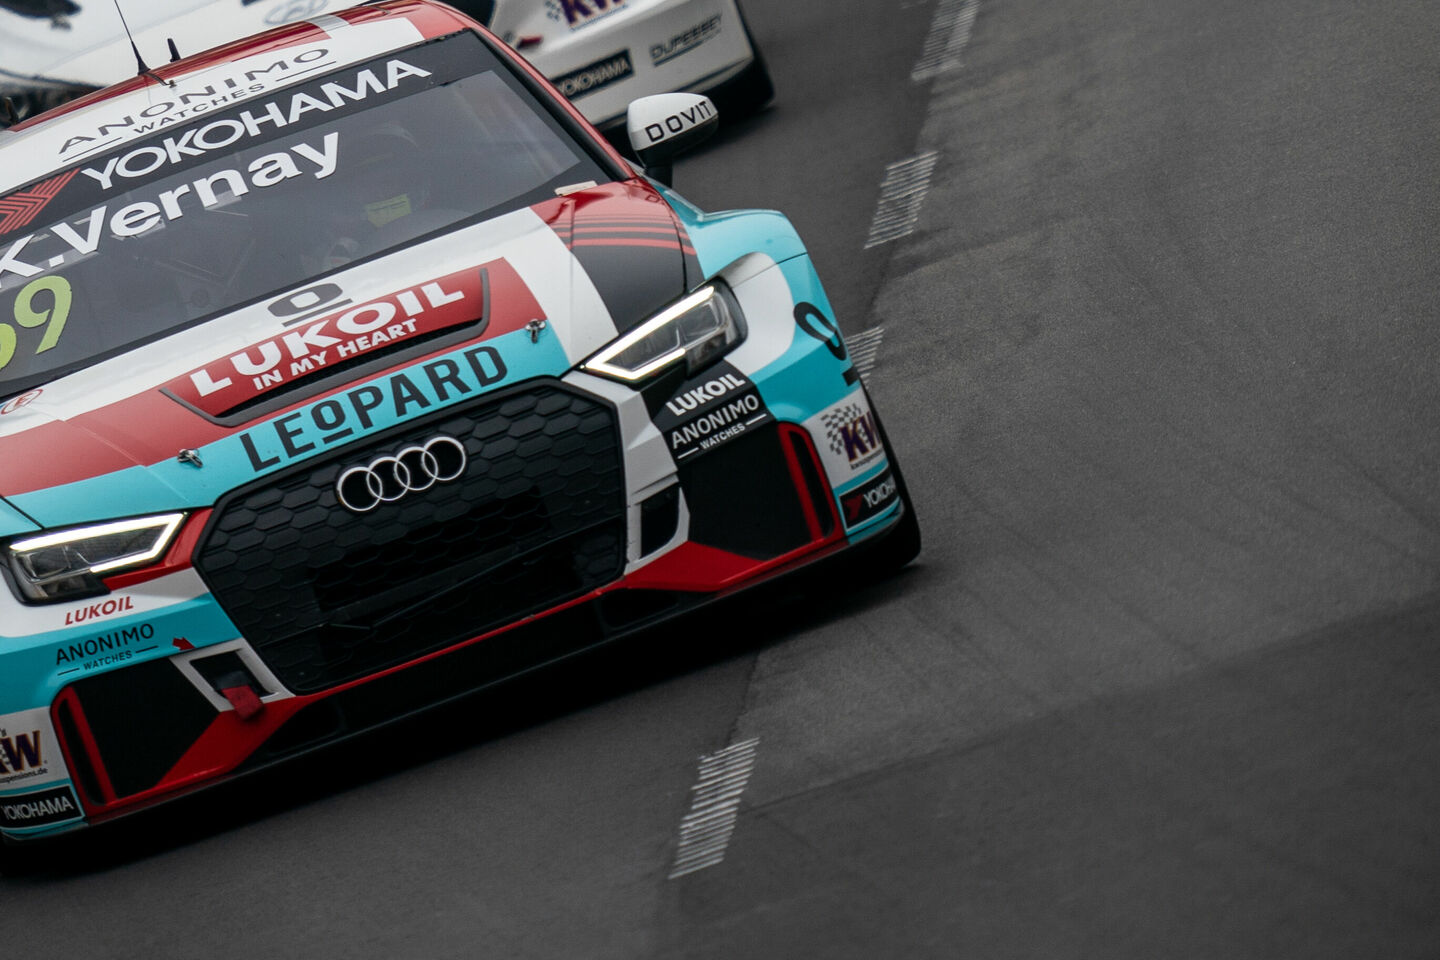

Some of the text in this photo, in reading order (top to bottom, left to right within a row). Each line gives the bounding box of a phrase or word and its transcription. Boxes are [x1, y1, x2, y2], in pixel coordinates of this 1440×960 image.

[59, 47, 330, 155] ANONIMO
[80, 59, 433, 191] YOKOHAMA
[133, 82, 266, 134] WATCHES
[644, 100, 712, 143] DOVIT
[189, 281, 465, 397] LUKOIL
[252, 317, 418, 392] IN MY HEART
[239, 345, 509, 473] LEOPARD
[665, 373, 747, 417] LUKOIL
[671, 394, 760, 450] ANONIMO
[699, 422, 746, 450] WATCHES
[64, 595, 134, 626] LUKOIL
[55, 623, 155, 666] ANONIMO
[82, 649, 133, 671] WATCHES
[0, 795, 75, 821] YOKOHAMA
